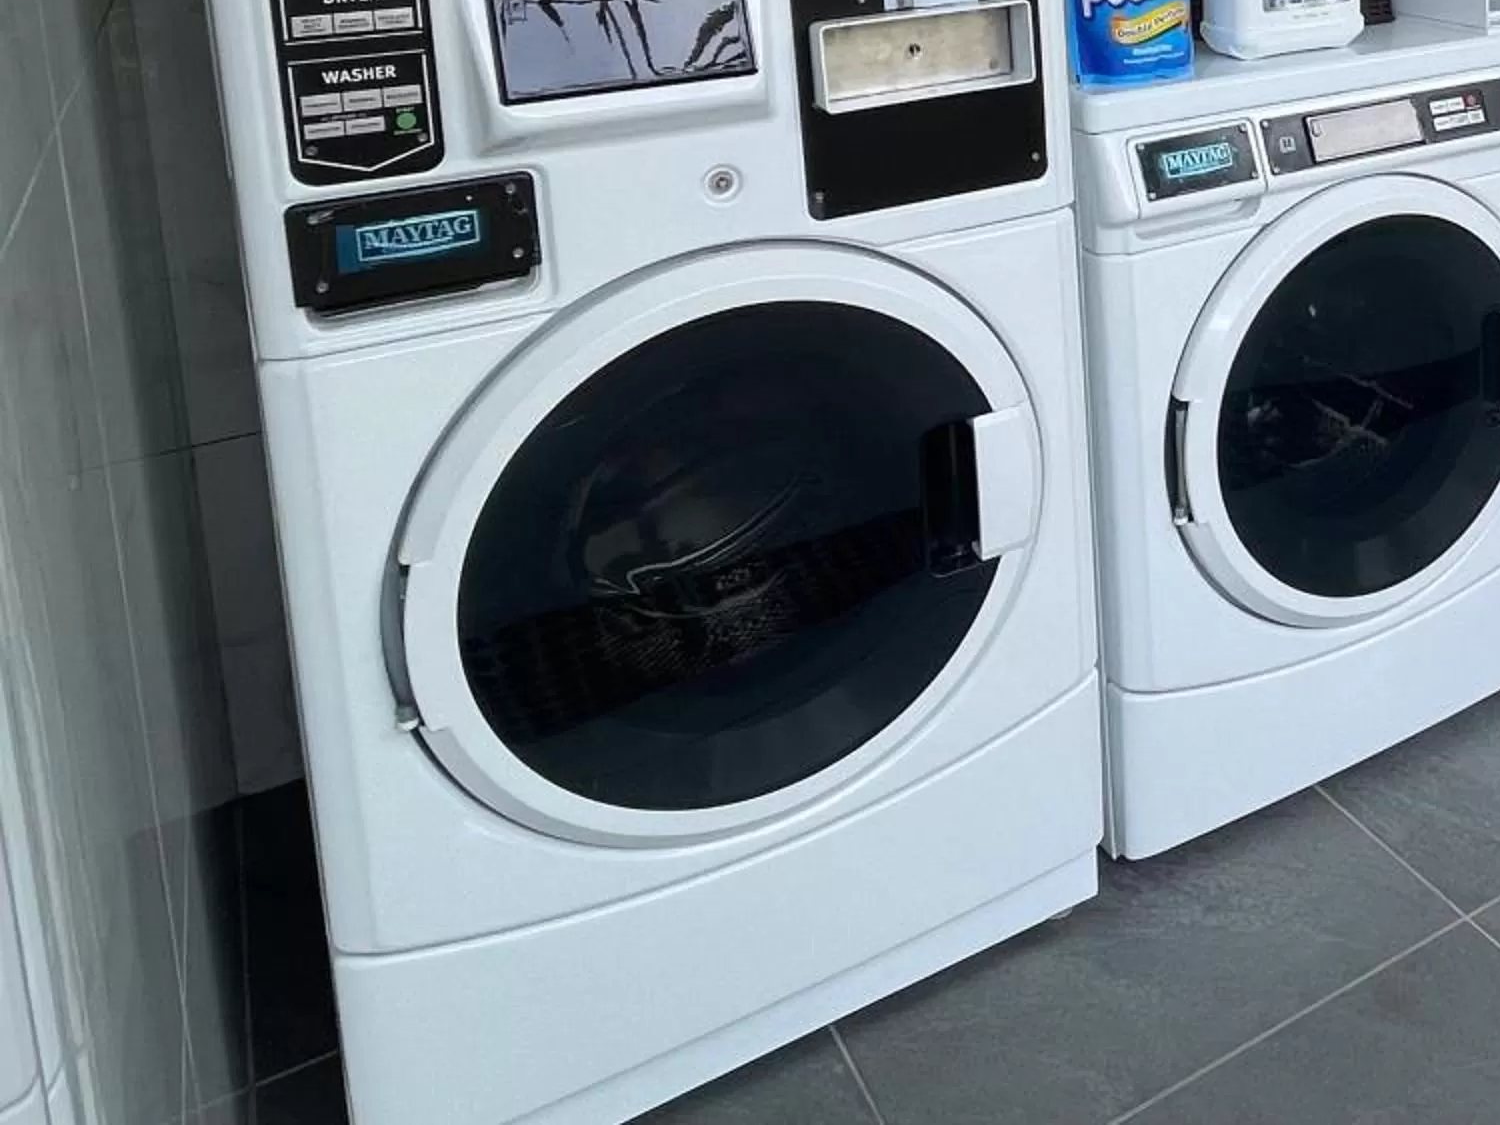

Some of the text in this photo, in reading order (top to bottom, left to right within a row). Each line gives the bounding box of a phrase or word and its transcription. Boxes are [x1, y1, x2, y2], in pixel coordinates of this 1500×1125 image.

[321, 64, 397, 84] WASHER
[1168, 145, 1228, 170] MAYTAG
[363, 216, 472, 250] MAYTAG
